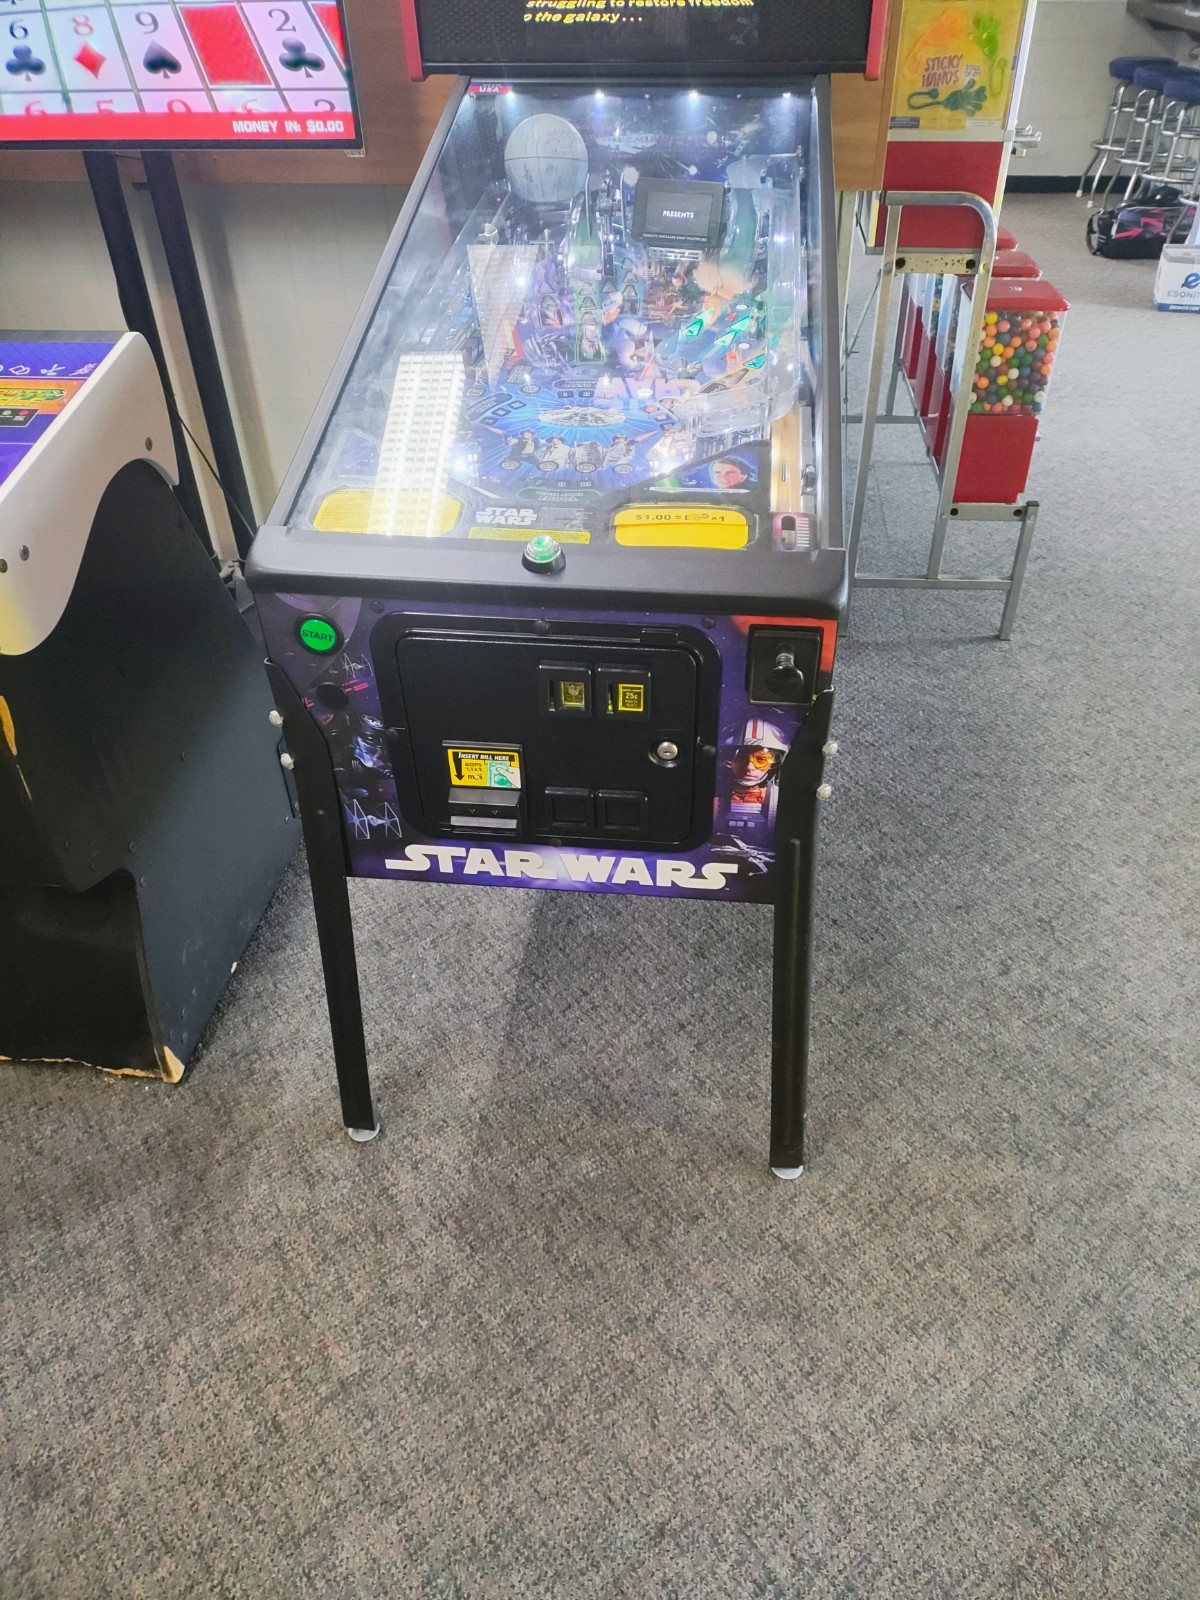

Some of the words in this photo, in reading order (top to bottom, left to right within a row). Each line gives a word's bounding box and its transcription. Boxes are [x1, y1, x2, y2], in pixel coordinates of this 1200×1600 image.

[526, 0, 606, 9] struggling
[610, 0, 625, 8] to
[535, 11, 562, 22] the
[9, 18, 29, 40] 6
[71, 14, 94, 36] 8
[135, 11, 159, 34] 9
[268, 8, 297, 32] 2
[925, 54, 963, 72] STICKY
[922, 70, 959, 88] HANDS
[232, 120, 278, 133] MONEY
[284, 120, 302, 133] IN:
[306, 119, 344, 134] $0.00
[662, 210, 694, 219] PRESENTS
[1167, 290, 1200, 298] EBONIT
[476, 507, 538, 517] STAR
[635, 513, 672, 521] $1.00
[476, 515, 537, 525] WARS
[302, 630, 334, 643] START
[458, 751, 480, 760] INSERT
[385, 844, 557, 880] STAR
[560, 853, 738, 890] WARS
